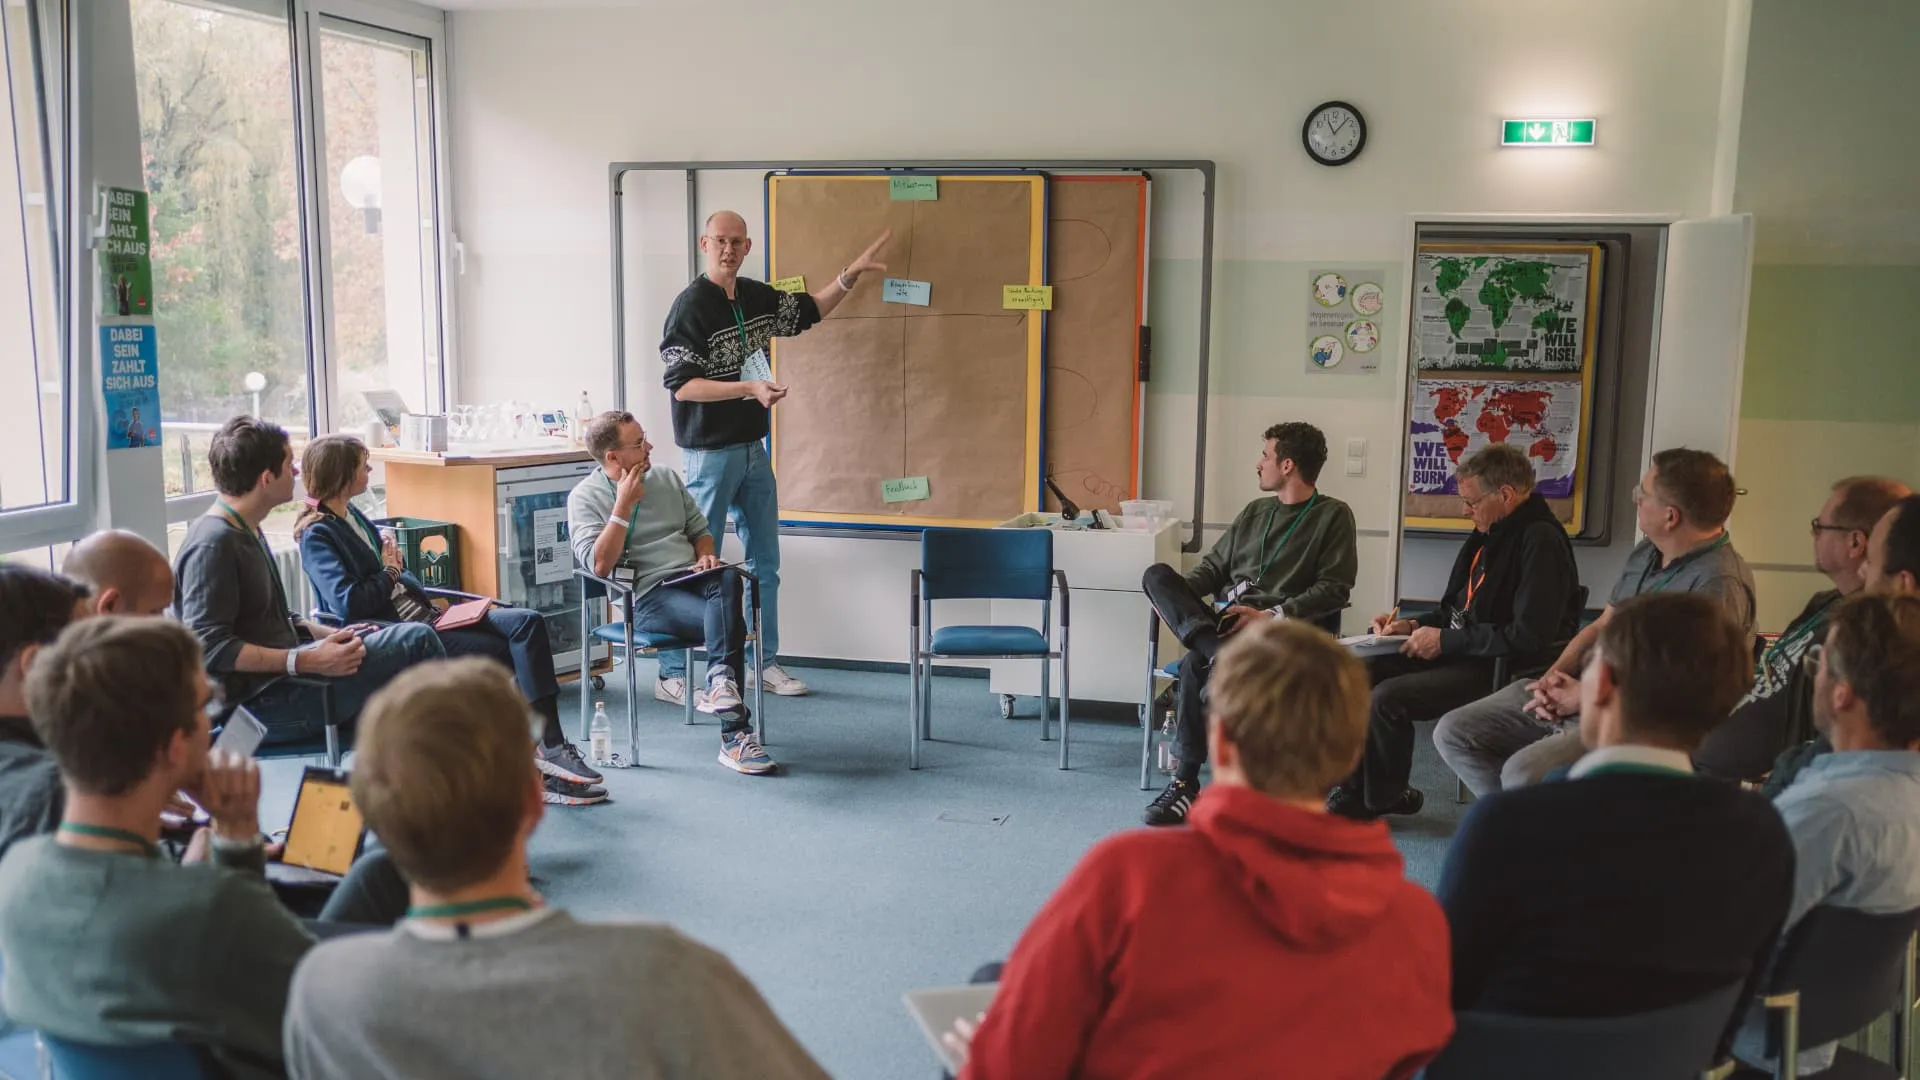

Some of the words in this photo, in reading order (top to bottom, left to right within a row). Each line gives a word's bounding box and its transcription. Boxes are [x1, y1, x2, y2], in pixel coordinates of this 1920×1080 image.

[1332, 111, 1339, 119] 12
[109, 191, 135, 206] ABEI
[109, 224, 138, 239] AHLT
[123, 241, 146, 256] AUS
[1545, 316, 1578, 334] WE
[110, 328, 143, 342] DABEI
[1544, 334, 1577, 347] WILL
[113, 343, 139, 357] SEIN
[1544, 348, 1576, 362] RISE!
[111, 359, 146, 374] ZAHLT
[105, 376, 131, 390] SICH
[132, 375, 155, 388] AUS
[1414, 441, 1447, 457] WE
[1413, 457, 1447, 471] WILL
[1413, 470, 1447, 485] BURN
